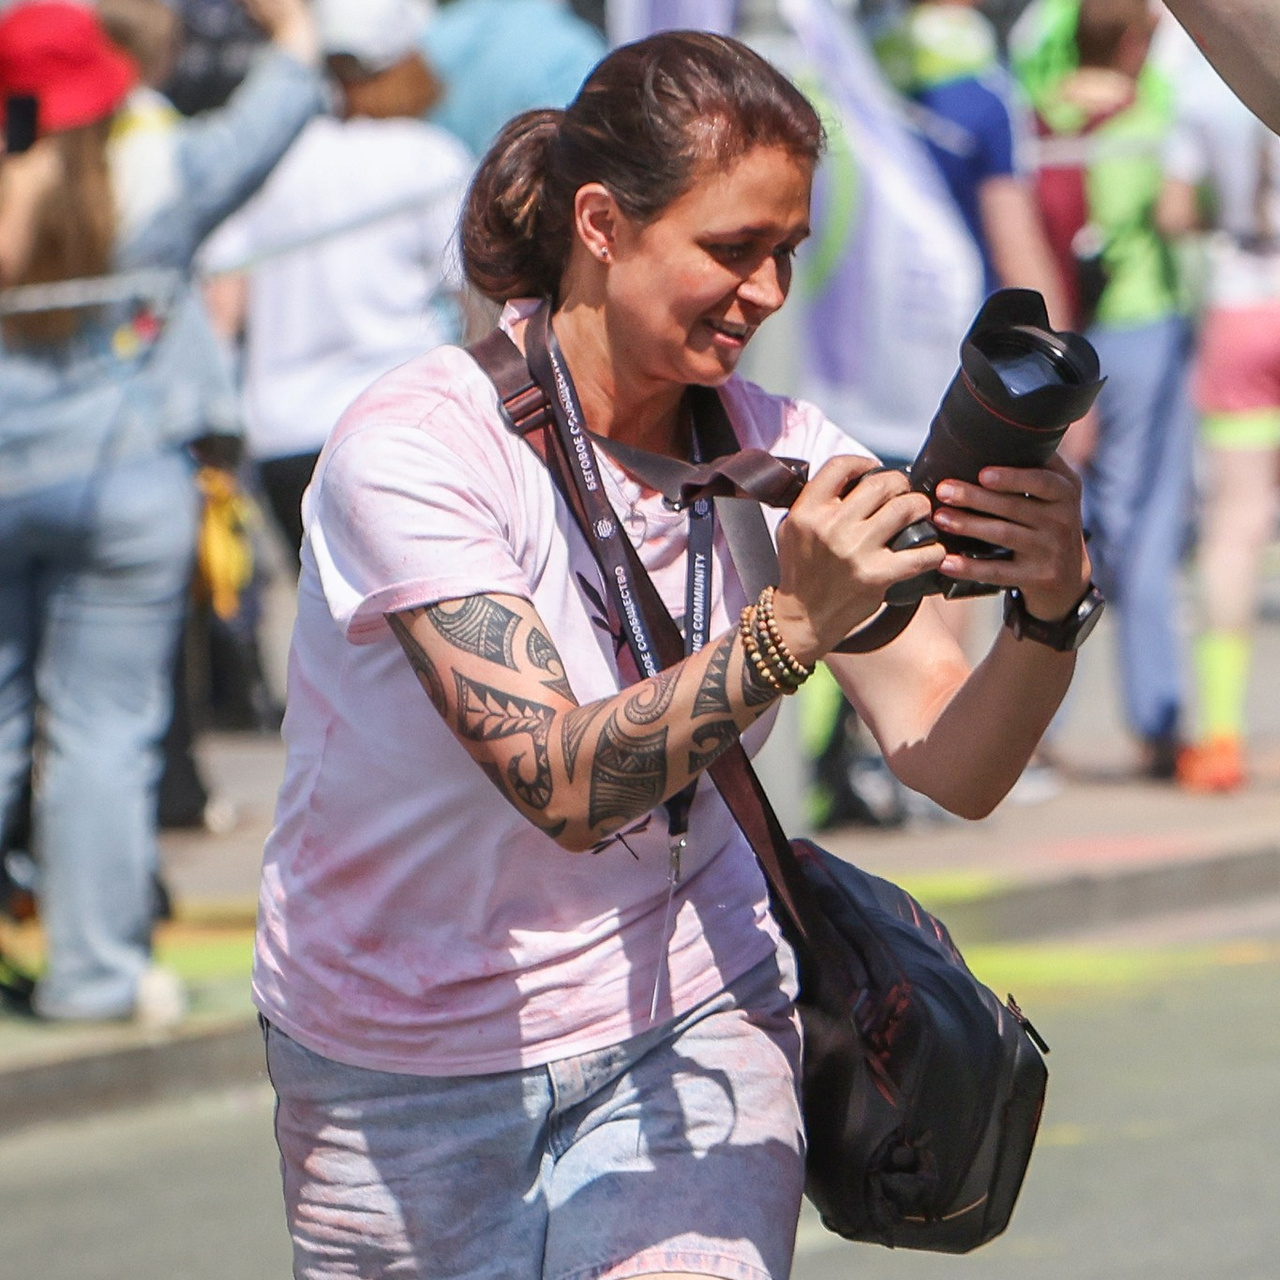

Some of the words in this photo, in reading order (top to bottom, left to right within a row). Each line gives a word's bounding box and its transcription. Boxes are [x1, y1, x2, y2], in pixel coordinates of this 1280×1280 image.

[573, 435, 598, 491] БЕГОВОЕ
[614, 565, 649, 650] СООБЩЕСТВО
[693, 553, 706, 630] COMMUNITY
